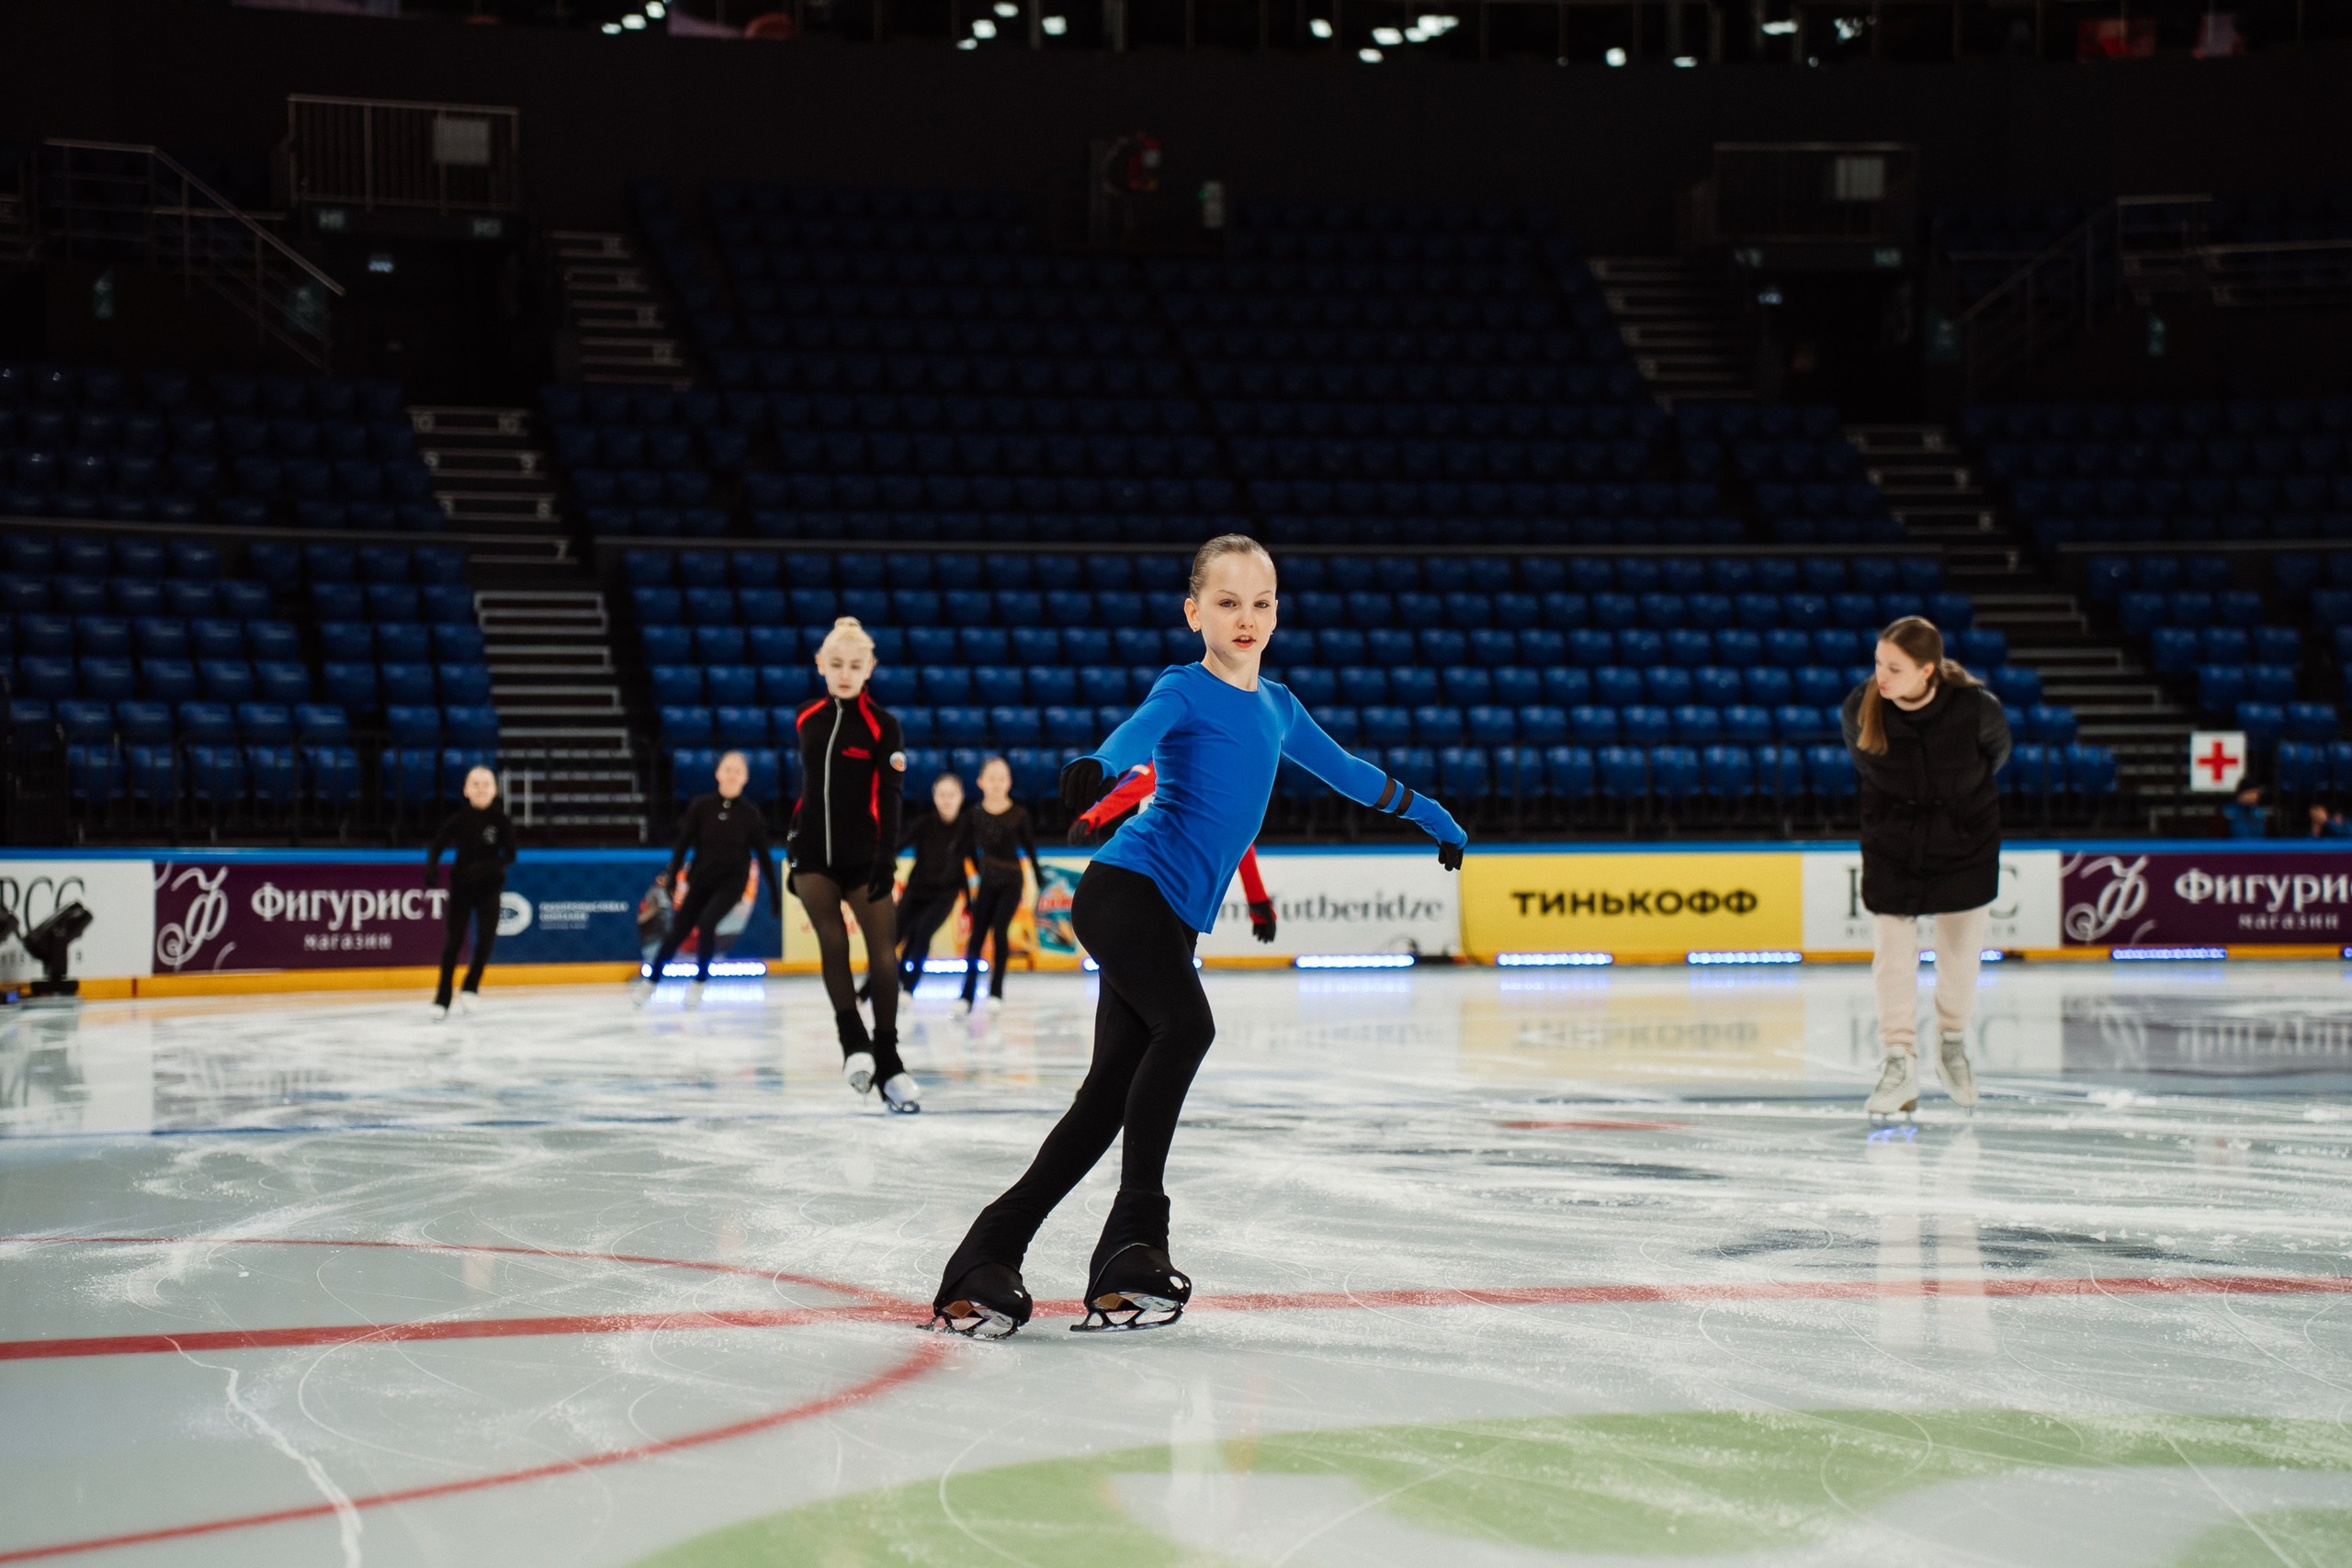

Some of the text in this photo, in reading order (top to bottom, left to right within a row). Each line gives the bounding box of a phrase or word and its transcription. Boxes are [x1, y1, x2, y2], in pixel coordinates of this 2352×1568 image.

[1511, 889, 1758, 916] ТИНЬКОФФ
[2174, 867, 2352, 912] Фигури
[251, 882, 449, 931] Фигурист
[1268, 889, 1443, 921] utberidze
[2237, 912, 2339, 931] магазин
[303, 933, 392, 951] магазин
